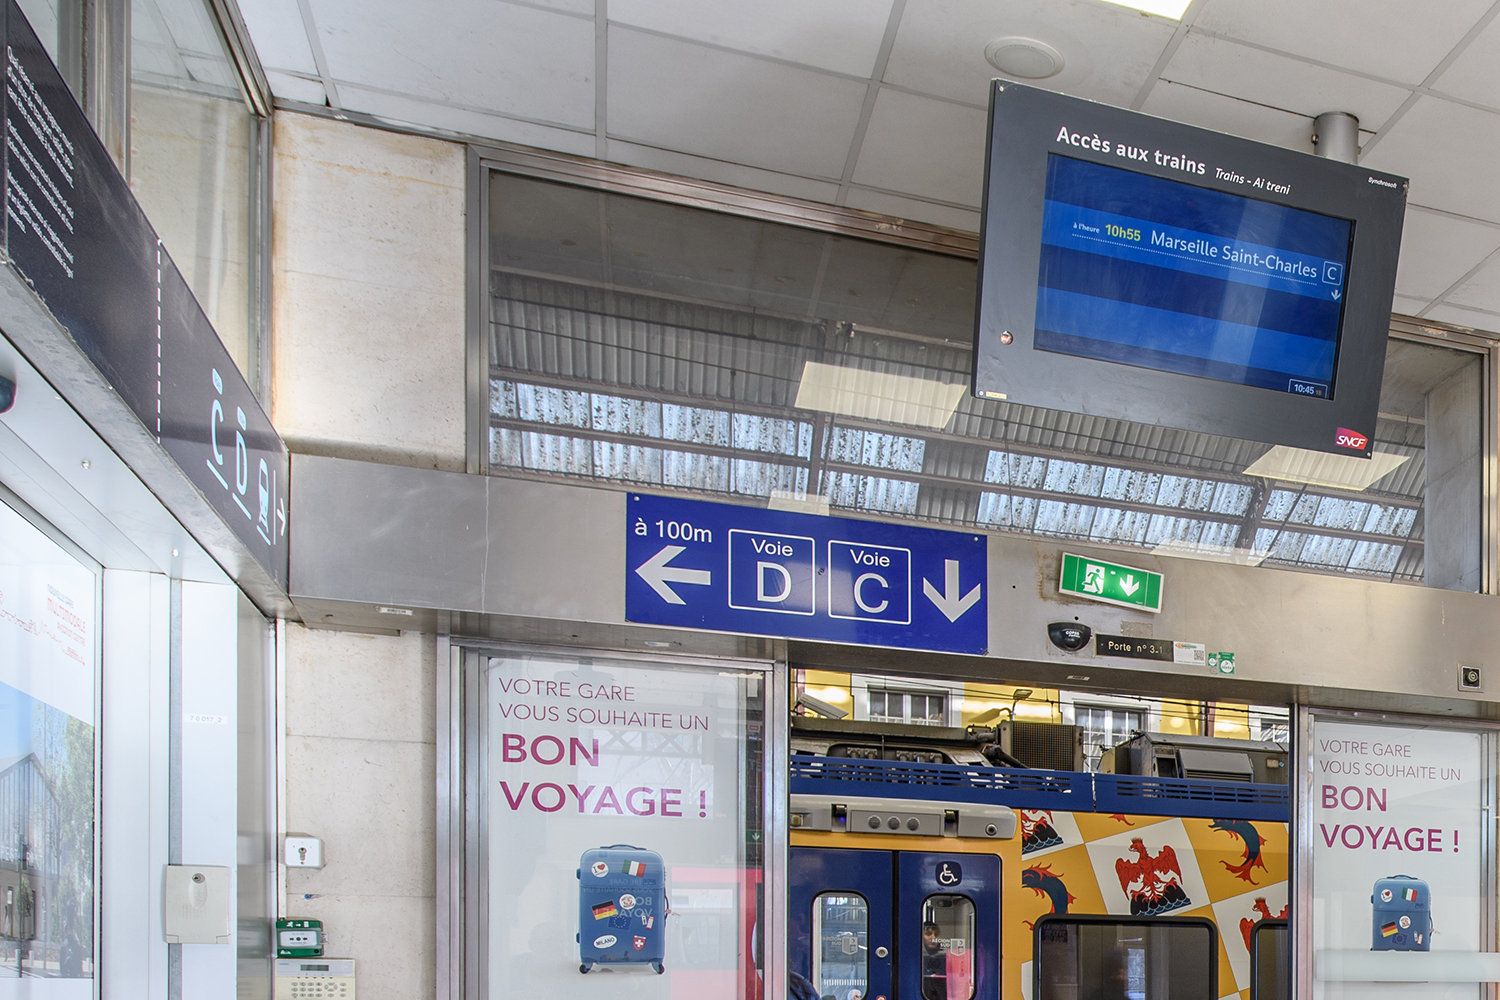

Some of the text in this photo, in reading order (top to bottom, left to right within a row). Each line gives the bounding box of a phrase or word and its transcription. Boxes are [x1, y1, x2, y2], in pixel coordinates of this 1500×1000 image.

[1057, 126, 1206, 175] Accès aux trains
[1215, 168, 1290, 195] Trains Ai treni
[1073, 221, 1141, 242] à l'heure 10h55
[1151, 230, 1317, 278] Marseille Saint-Charles
[1327, 267, 1337, 280] C
[1294, 384, 1314, 394] 10:45
[211, 399, 224, 466] C
[1336, 435, 1366, 448] SNCF
[236, 430, 248, 496] D
[635, 518, 712, 543] à 100m
[751, 538, 793, 557] Voie
[850, 549, 890, 568] Voie
[757, 561, 792, 603] D
[854, 573, 889, 613] C
[1108, 641, 1147, 653] Porte n°
[499, 678, 635, 702] VOTRE GARE
[499, 703, 709, 730] VOUS SOUHAITE UN
[502, 734, 599, 767] BON
[1320, 739, 1412, 758] VOTRE GARE
[1320, 760, 1461, 781] VOUS SOUHAITE UN
[499, 781, 707, 818] VOYAGE !
[1322, 785, 1387, 812] BON
[1320, 824, 1459, 853] VOYAGE !
[596, 937, 615, 946] MILANO
